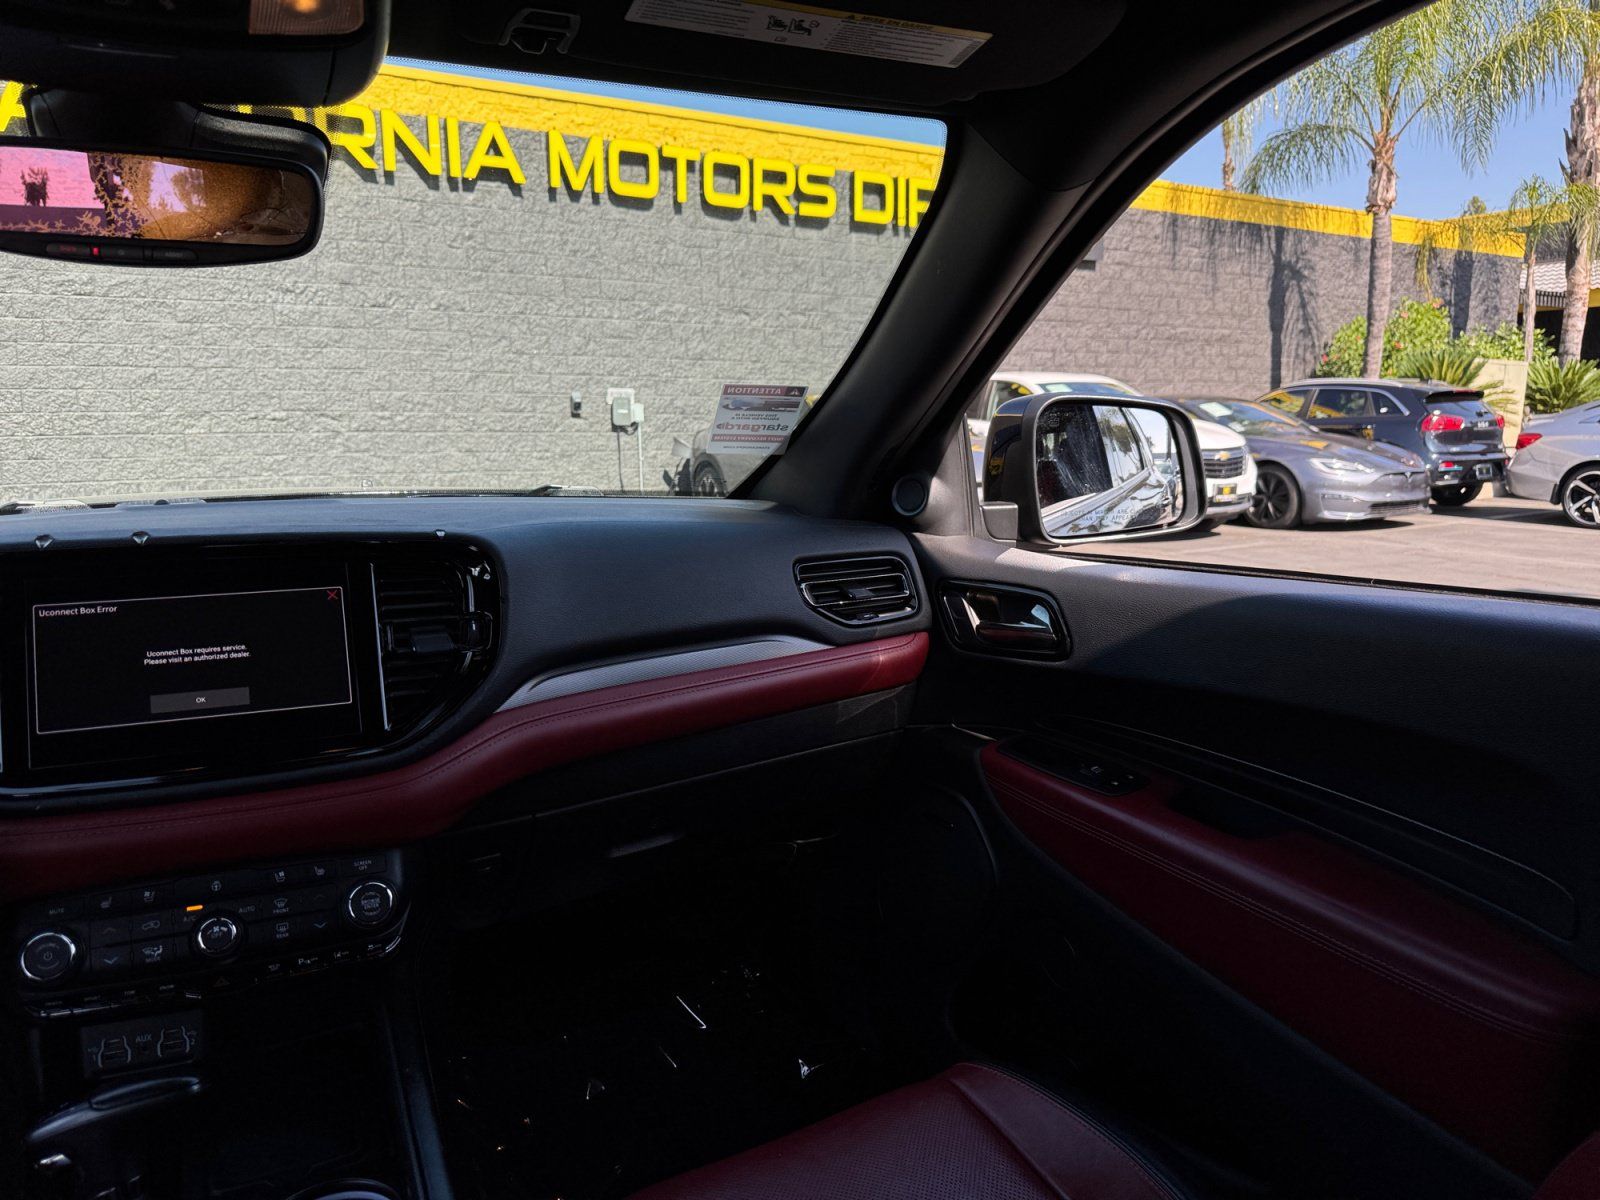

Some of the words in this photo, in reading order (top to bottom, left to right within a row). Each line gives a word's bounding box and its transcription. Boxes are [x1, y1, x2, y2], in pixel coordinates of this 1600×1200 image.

[548, 129, 838, 218] MOTORS
[39, 607, 78, 617] Uconnect
[80, 606, 95, 615] Box
[97, 605, 118, 613] Error
[146, 649, 179, 658] Uconnect
[194, 646, 221, 655] requires
[144, 657, 168, 665] Please
[193, 653, 228, 661] authorized
[238, 905, 256, 914] AUTO
[136, 1033, 152, 1043] AUX
